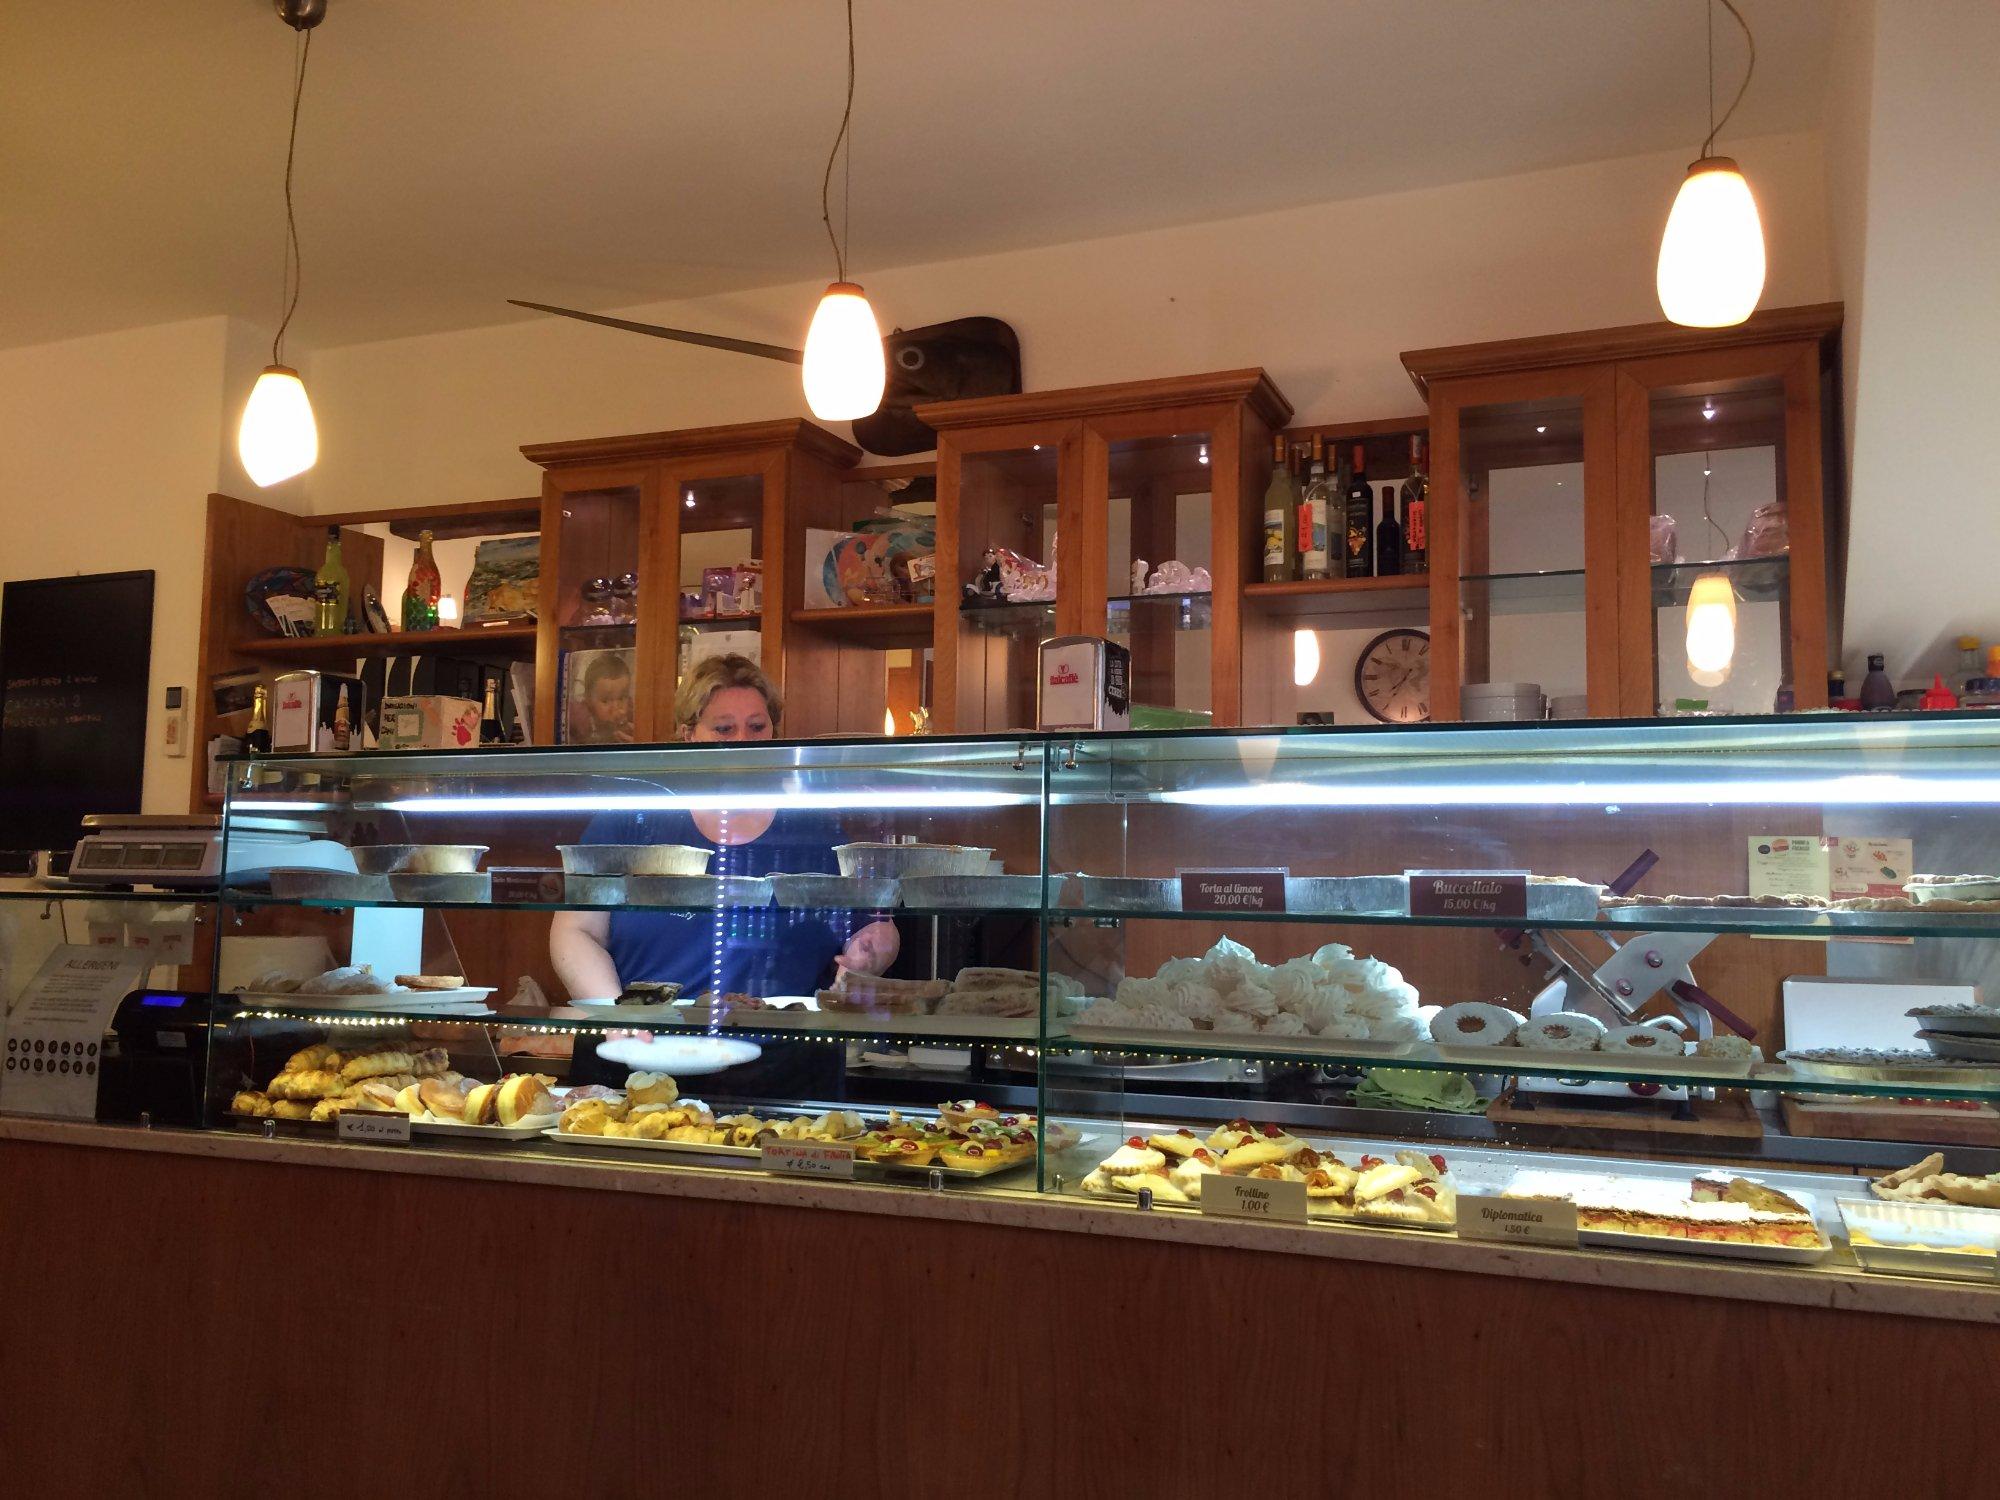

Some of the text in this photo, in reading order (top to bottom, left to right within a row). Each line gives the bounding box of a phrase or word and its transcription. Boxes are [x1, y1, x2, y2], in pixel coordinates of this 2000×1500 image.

[1200, 883, 1264, 894] Torta al limone
[1433, 879, 1503, 895] Buccellato
[1214, 894, 1241, 906] 20,00
[1234, 1186, 1270, 1199] Frollino
[1481, 1207, 1543, 1222] Diplomatica
